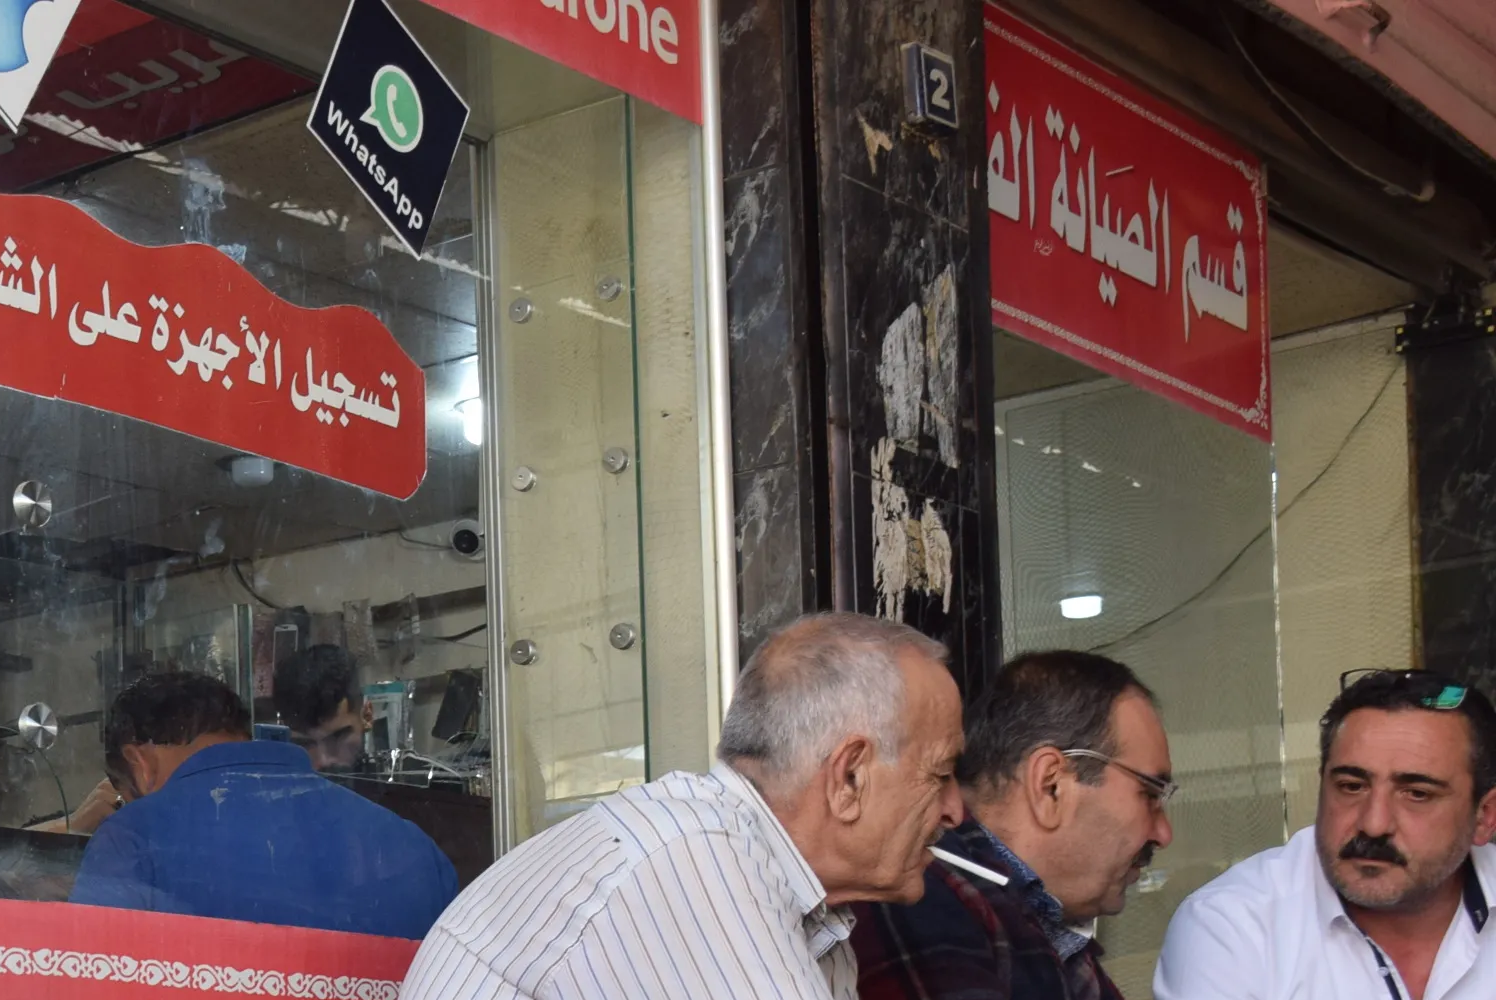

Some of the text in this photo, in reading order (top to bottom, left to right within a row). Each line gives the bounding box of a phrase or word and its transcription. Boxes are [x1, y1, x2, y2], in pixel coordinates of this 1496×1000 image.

[929, 68, 951, 111] 2
[326, 100, 424, 232] WhatsApp
[69, 281, 142, 346] على
[1182, 202, 1248, 343] قسم
[147, 294, 281, 389] الأجهزة
[290, 349, 401, 427] تسجيل
